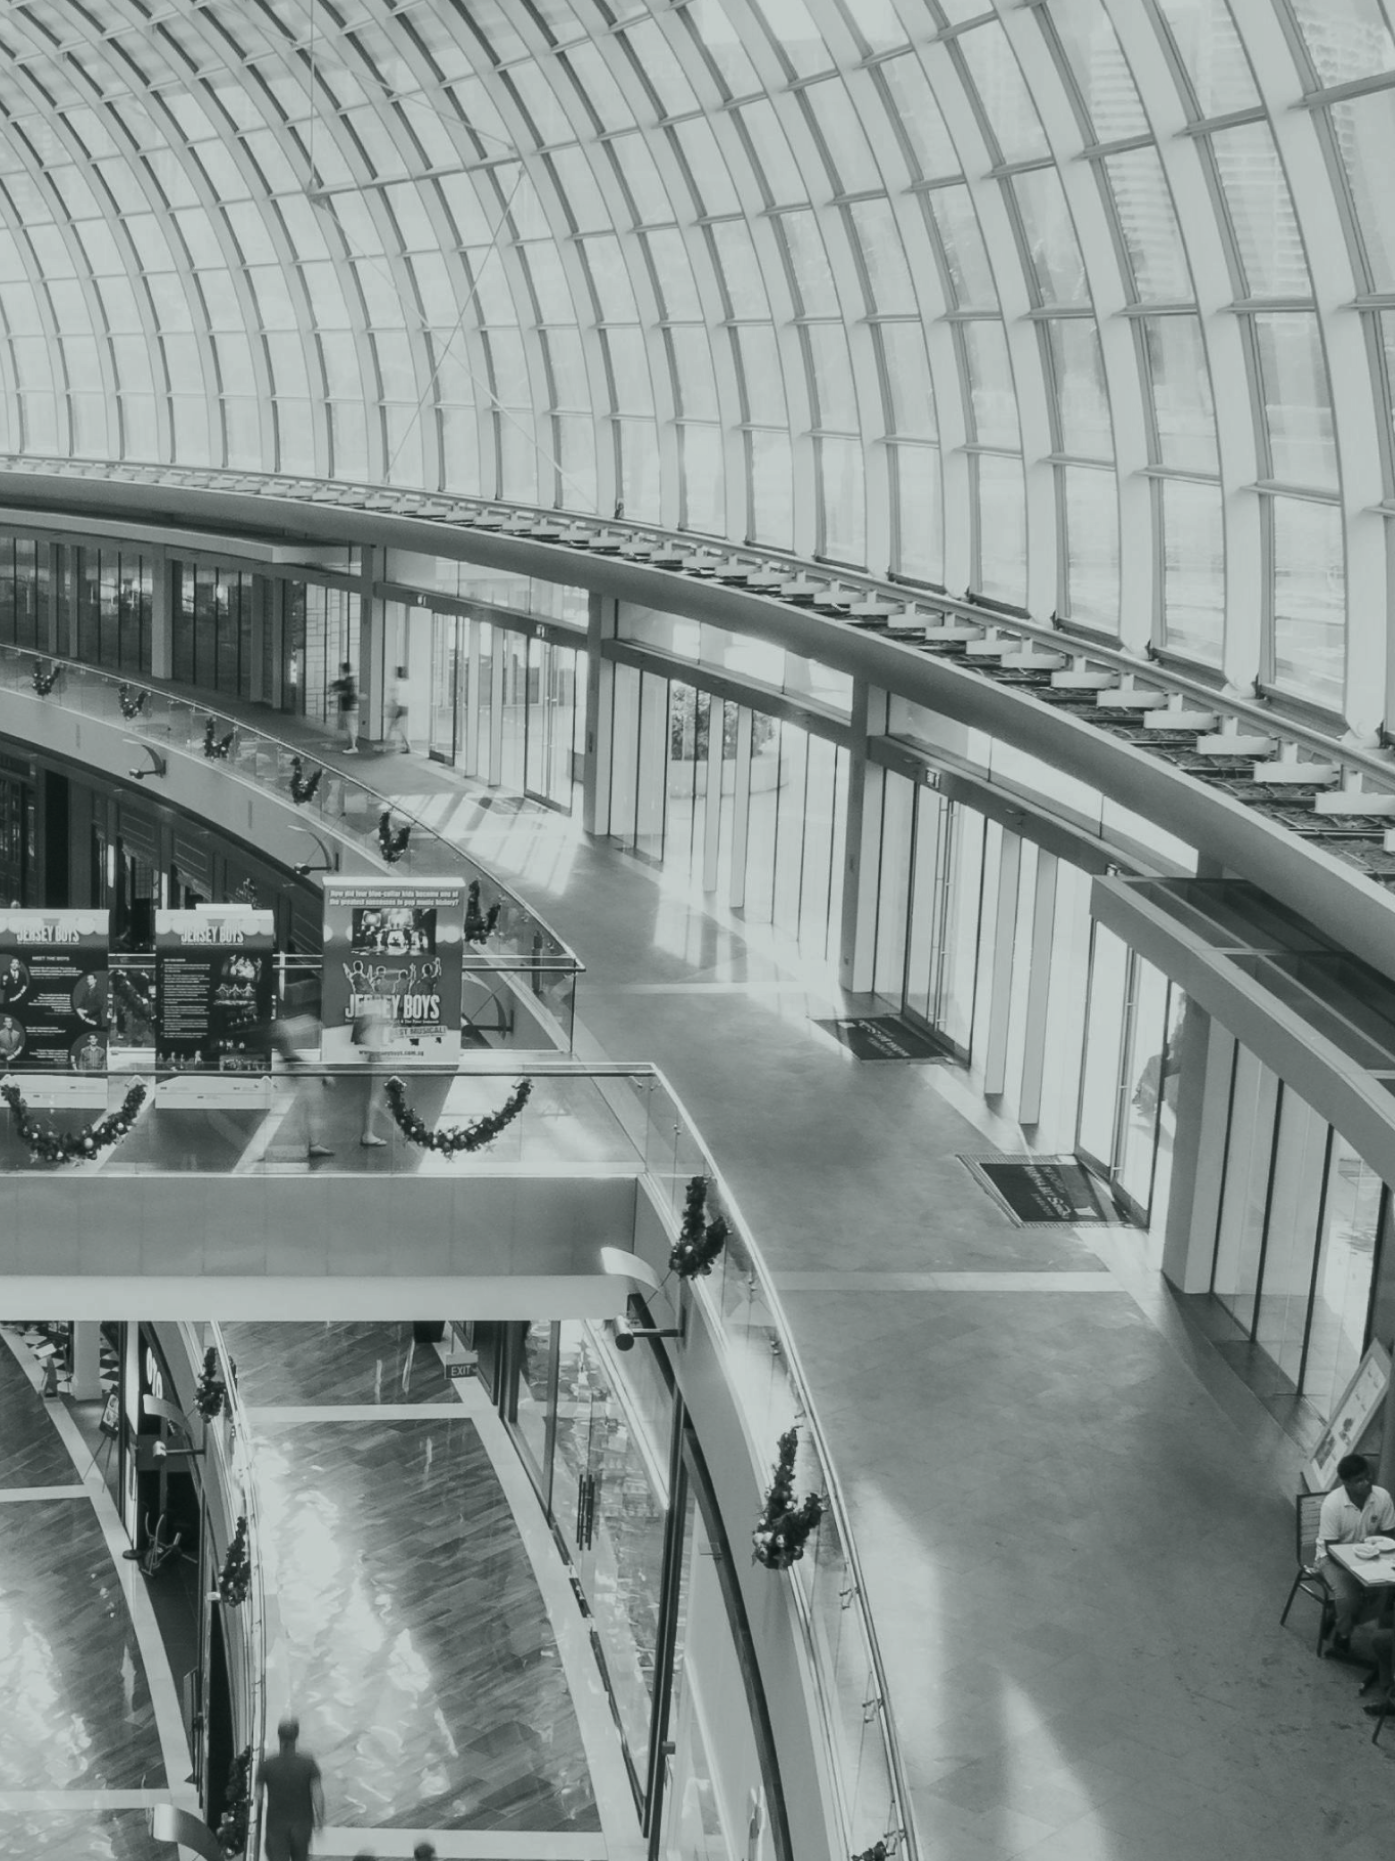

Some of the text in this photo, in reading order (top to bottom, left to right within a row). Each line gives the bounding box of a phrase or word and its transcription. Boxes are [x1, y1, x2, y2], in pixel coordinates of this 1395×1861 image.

[16, 924, 80, 942] JERSEY BOYS
[181, 925, 244, 943] JERSEY BOYS
[403, 994, 440, 1019] BOYS
